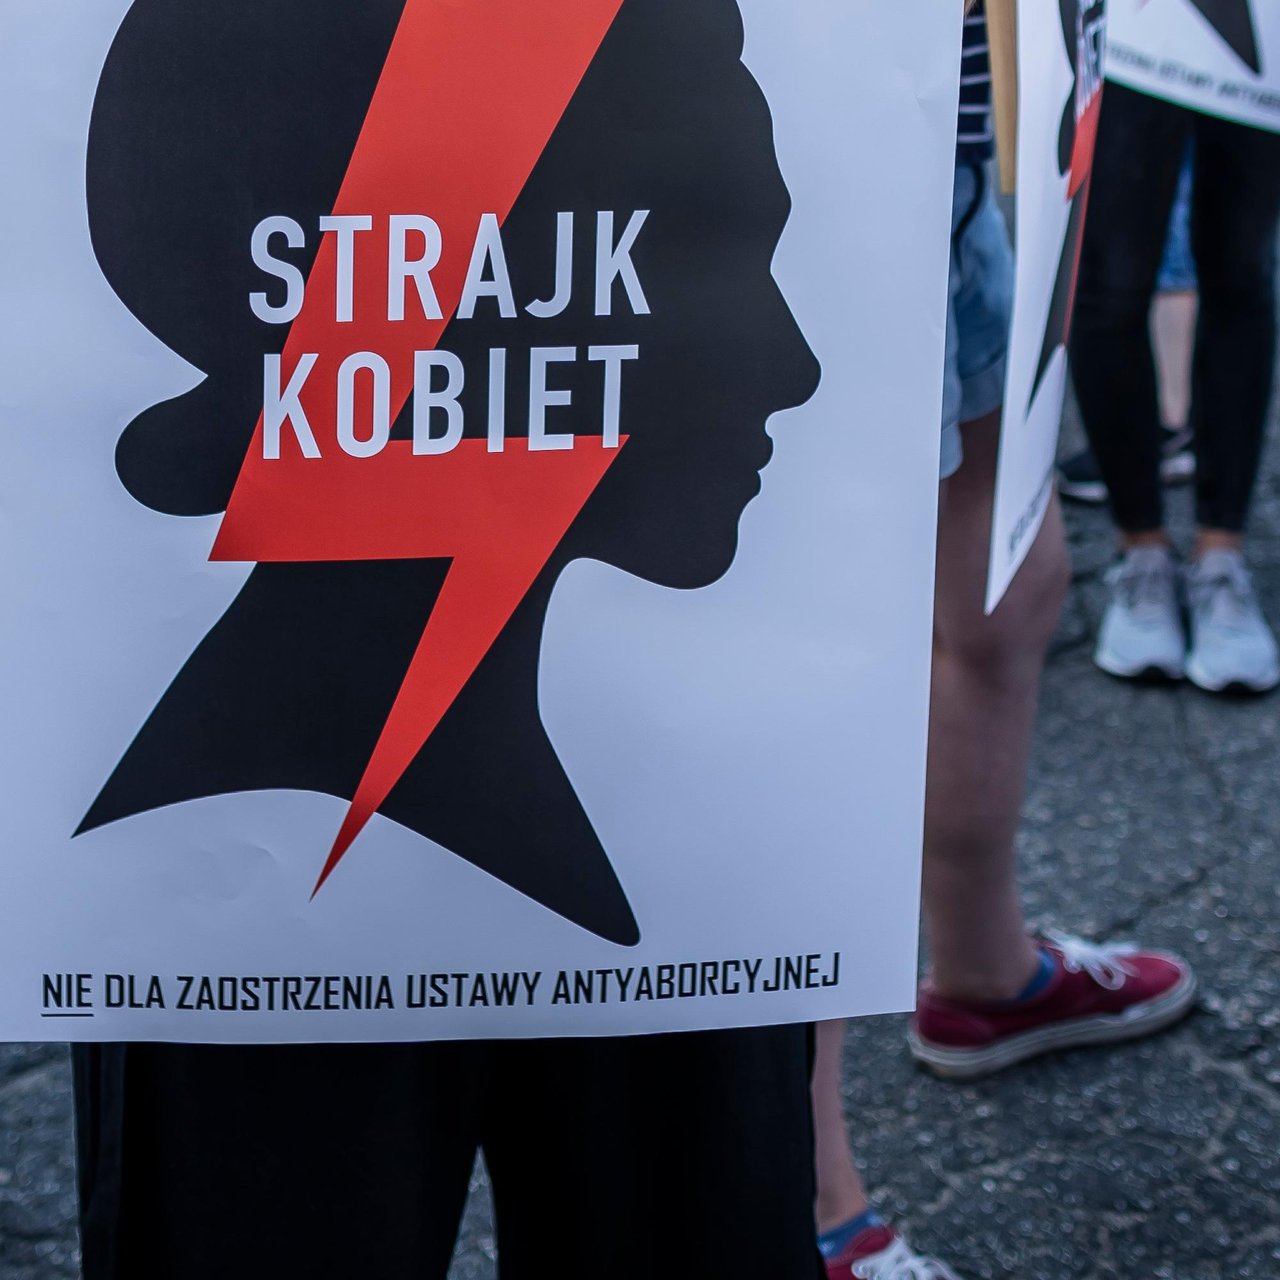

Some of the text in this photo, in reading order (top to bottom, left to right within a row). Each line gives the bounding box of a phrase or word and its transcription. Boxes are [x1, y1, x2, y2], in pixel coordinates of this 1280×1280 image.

[249, 209, 651, 324] STRAJK
[262, 344, 639, 460] KOBIET
[42, 952, 841, 1012] NIE DLA ZAOSTRZENIA USTAWY ANTYABORCYJNEJ
